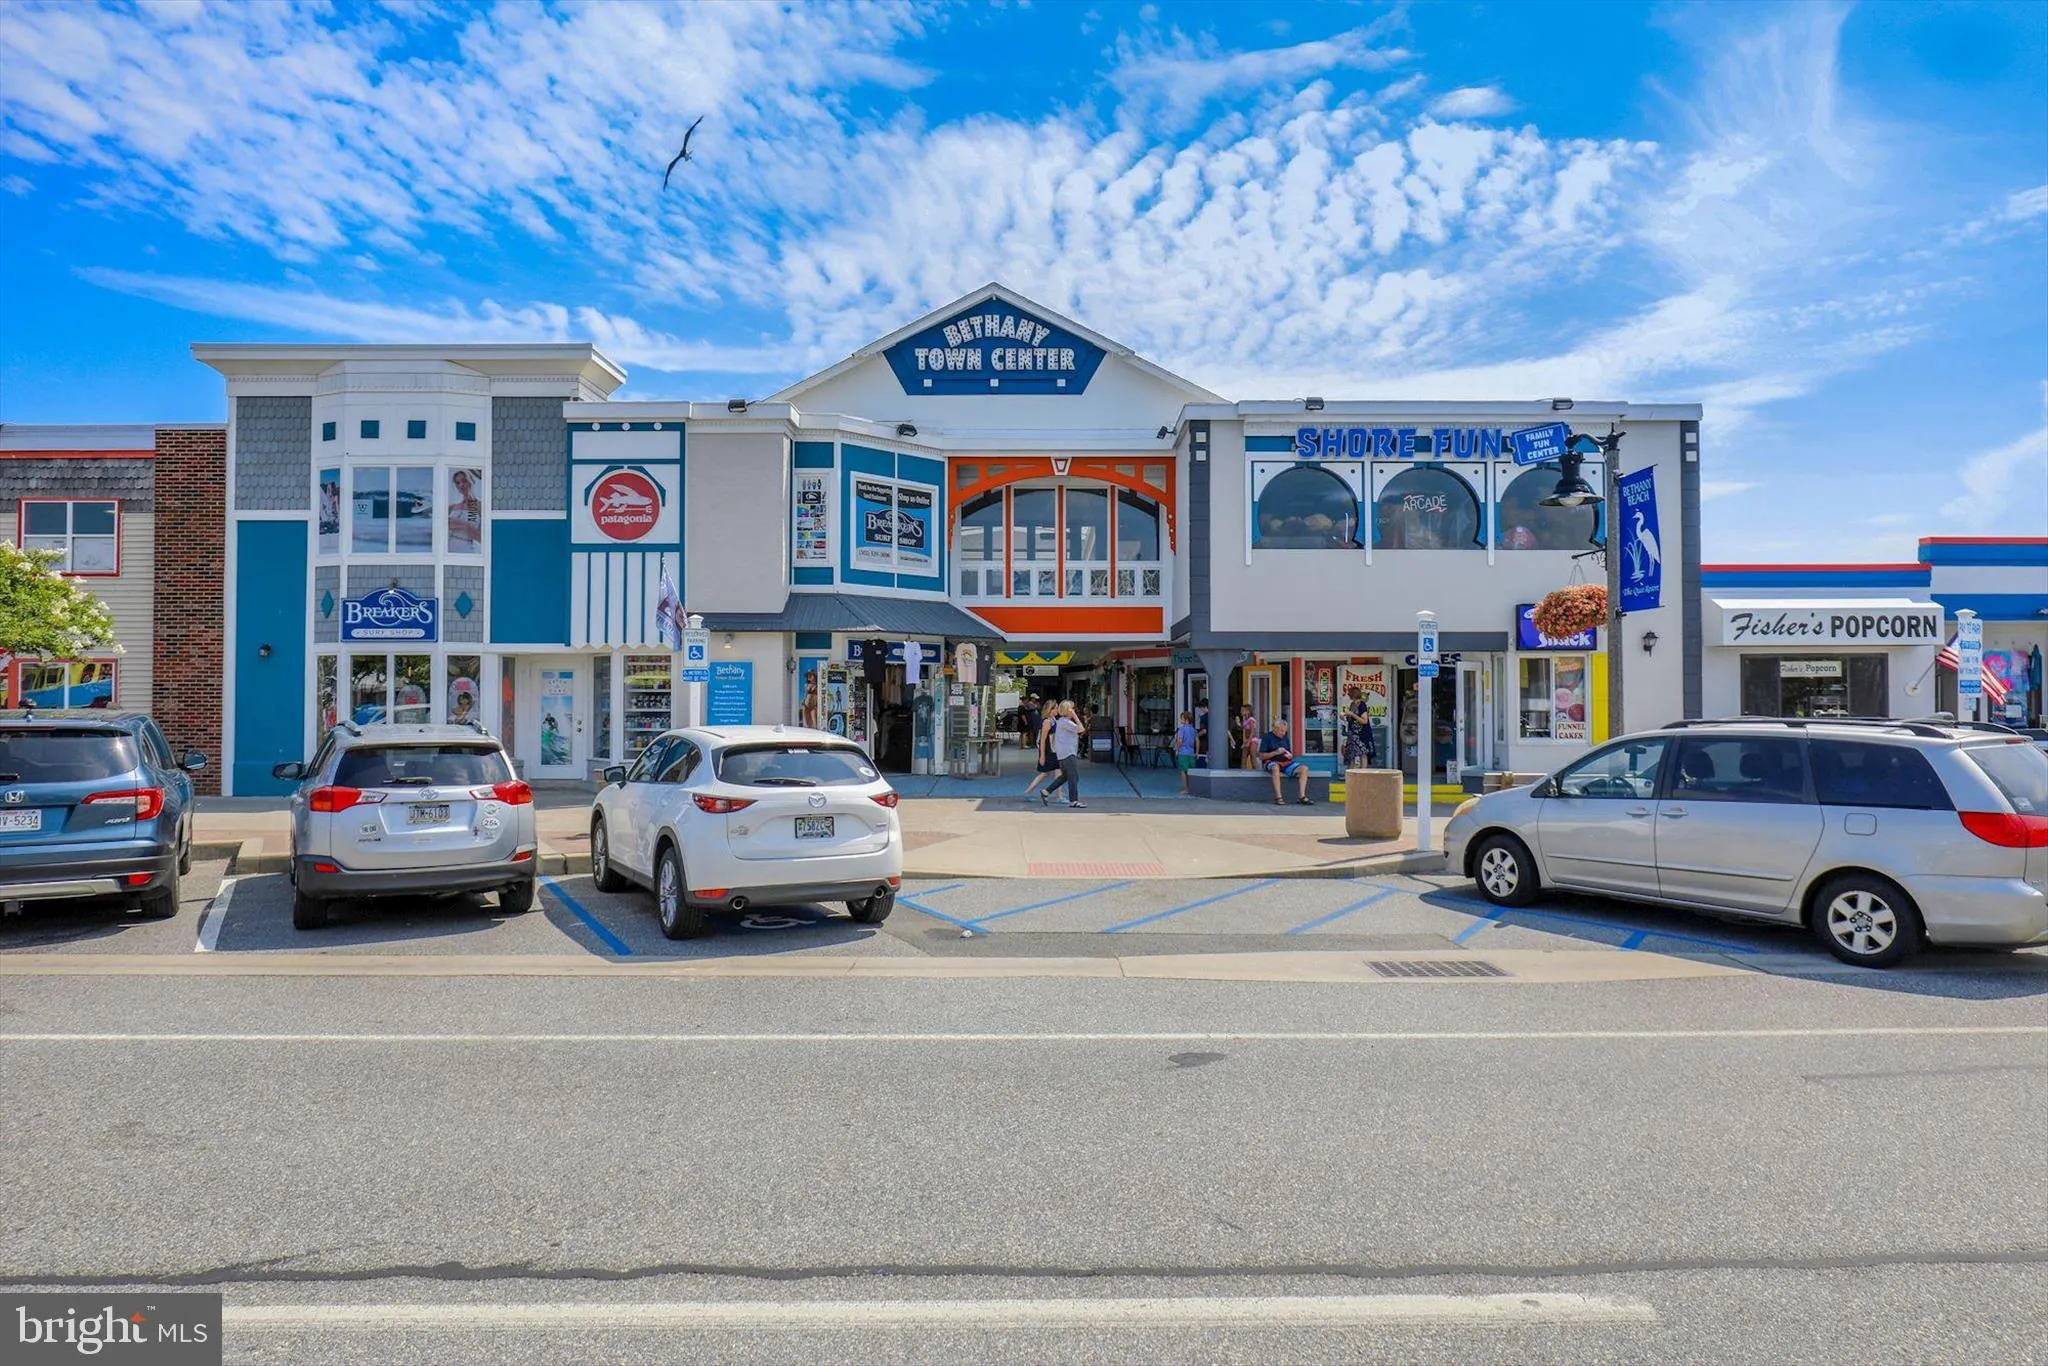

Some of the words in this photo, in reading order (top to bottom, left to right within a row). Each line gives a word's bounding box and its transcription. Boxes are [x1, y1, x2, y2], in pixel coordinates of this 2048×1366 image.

[942, 314, 1050, 348] BETHANY
[915, 348, 982, 371] TOWN
[991, 348, 1075, 371] CENTER
[1296, 427, 1417, 459] SHORE
[1431, 427, 1503, 459] FUN
[1525, 428, 1555, 443] FAMILY
[1526, 446, 1560, 460] CENTER
[1533, 440, 1550, 450] FUN
[1622, 478, 1652, 498] BETHANY
[1403, 495, 1447, 512] ARCADE
[1627, 491, 1650, 507] BEACH
[601, 514, 652, 525] patagonia
[899, 538, 917, 546] SHOP
[345, 601, 433, 626] BREAKERS
[1730, 612, 1824, 641] Fisher's
[1831, 615, 1937, 638] POPCORN
[1405, 652, 1463, 668] CES
[716, 664, 745, 678] Bethany
[1345, 670, 1383, 683] FRESH
[1805, 664, 1837, 674] Popcorn
